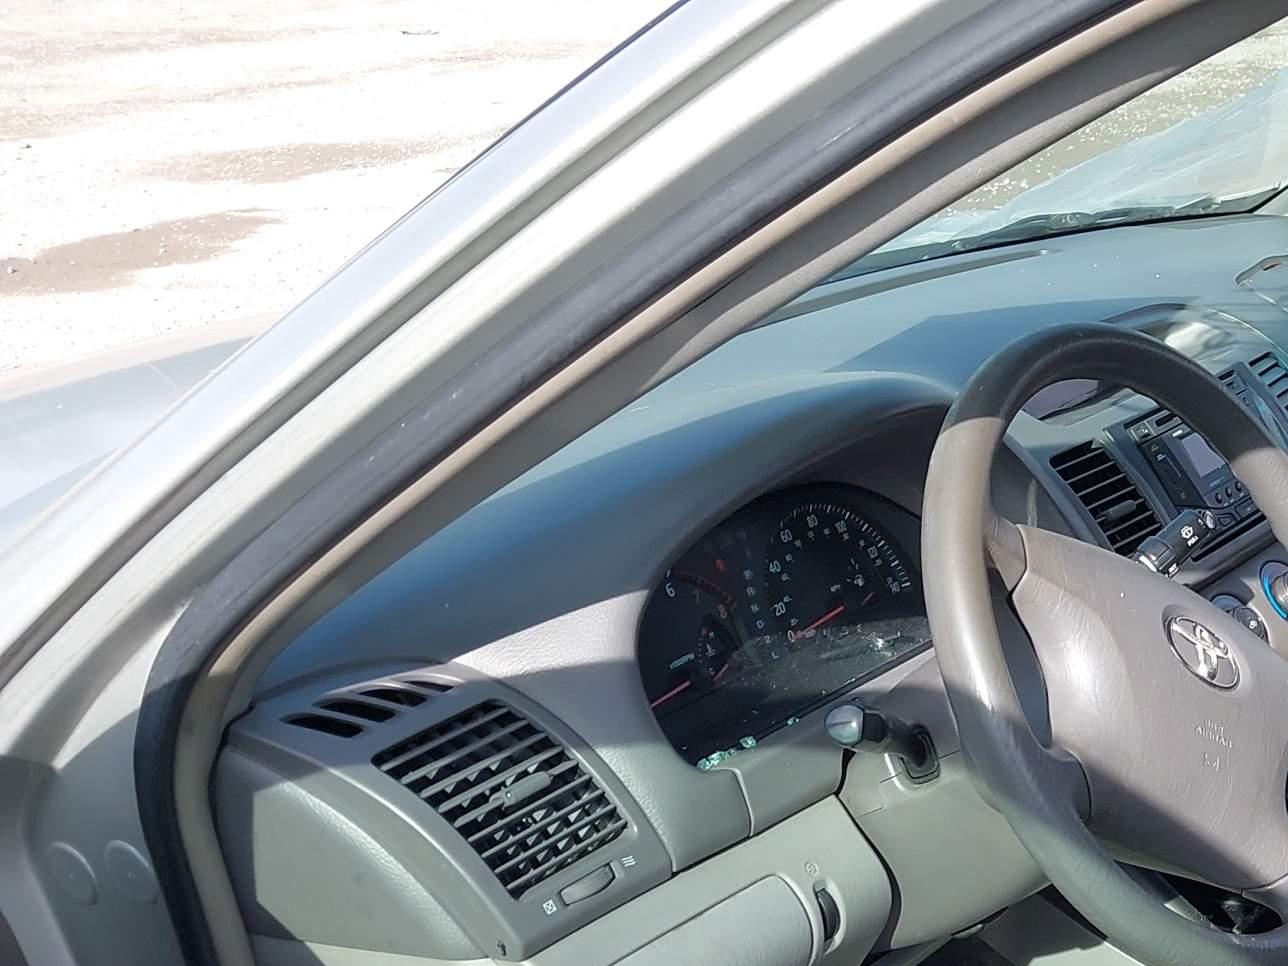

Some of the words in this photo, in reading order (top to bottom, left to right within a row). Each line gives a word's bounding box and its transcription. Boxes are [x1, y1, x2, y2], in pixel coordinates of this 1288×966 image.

[806, 514, 818, 528] 80
[780, 529, 793, 543] 60
[769, 560, 781, 574] 40
[665, 582, 676, 598] 6
[718, 604, 728, 619] 8
[773, 601, 786, 617] 20
[764, 634, 772, 645] 2
[770, 651, 779, 660] L
